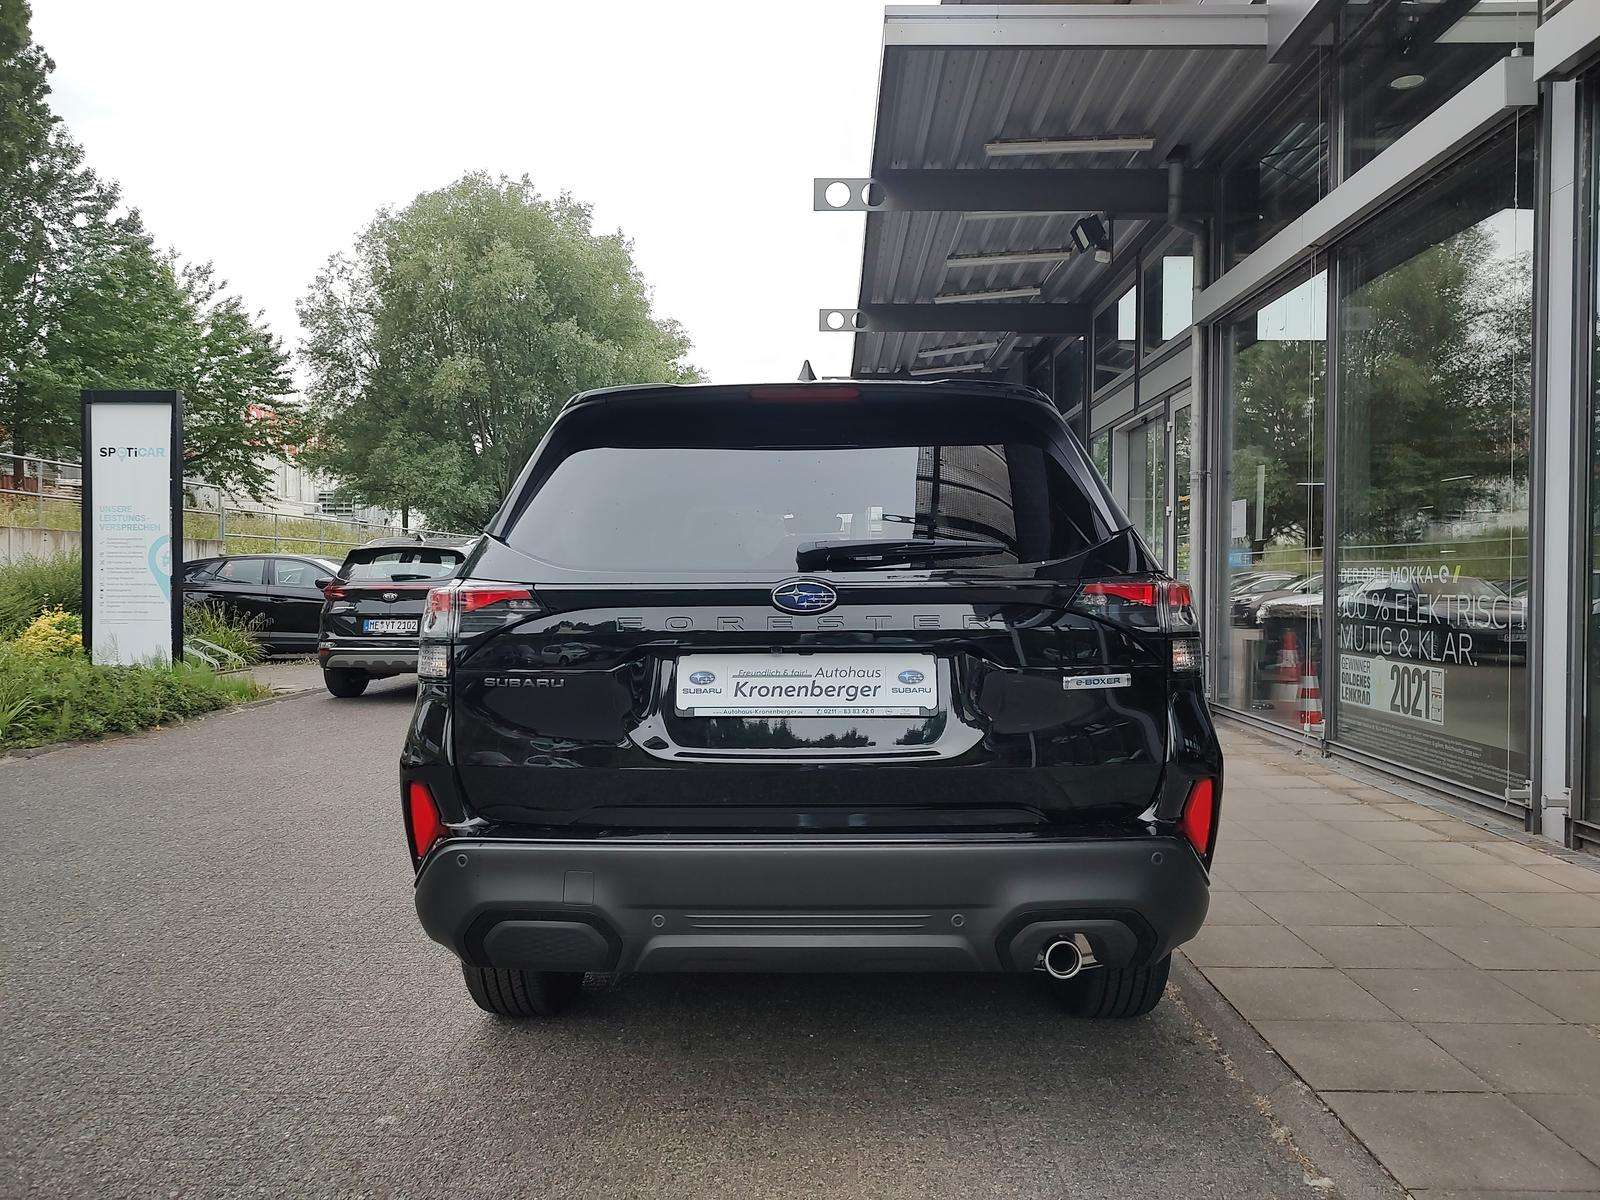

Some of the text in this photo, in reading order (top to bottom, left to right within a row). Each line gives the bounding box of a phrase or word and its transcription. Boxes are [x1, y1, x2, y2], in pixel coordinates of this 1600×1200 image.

[99, 505, 133, 513] UNSERE
[99, 514, 151, 523] LEISTUNGS-
[99, 523, 161, 532] VERSPRECHEN
[1371, 592, 1390, 621] %
[369, 620, 417, 631] ME YT 2102
[616, 614, 992, 632] FORESTER
[1340, 623, 1478, 668] MUTIG & KLAR.
[738, 669, 781, 679] Freundlich
[814, 666, 882, 678] Autohaus
[1341, 656, 1371, 675] GEWINNER
[483, 677, 565, 688] SUBARU
[1075, 677, 1121, 686] e-BOXER
[1341, 671, 1371, 690] GOLDENES
[682, 687, 722, 695] SUBARU
[733, 680, 882, 701] Kronenberger
[1341, 685, 1371, 706] LENKRAD
[1389, 664, 1431, 720] 2021
